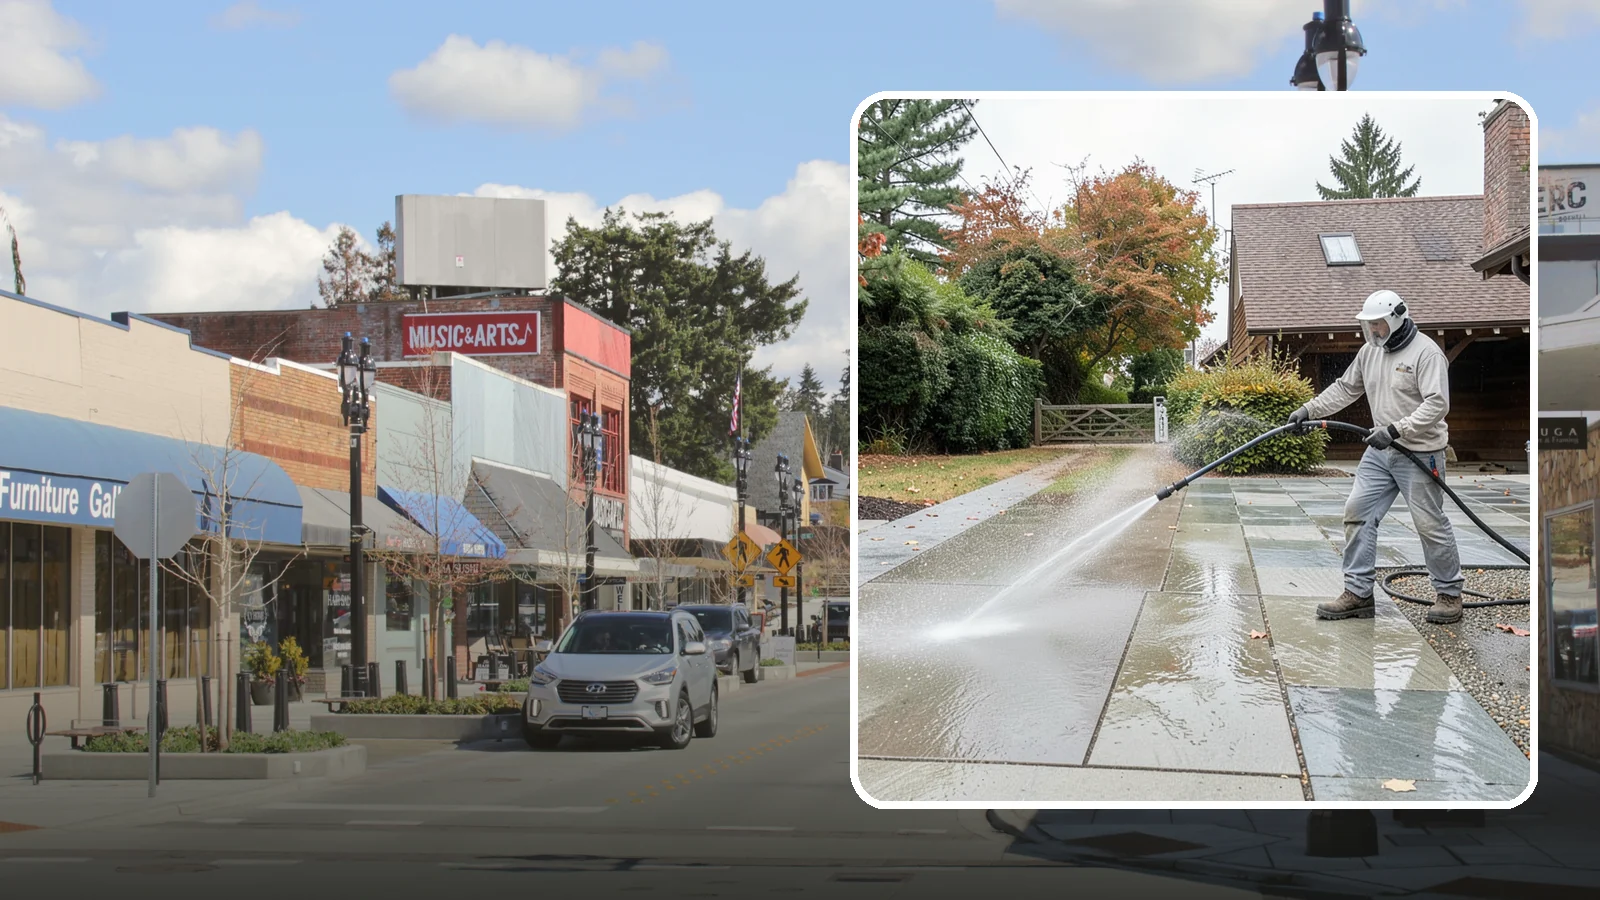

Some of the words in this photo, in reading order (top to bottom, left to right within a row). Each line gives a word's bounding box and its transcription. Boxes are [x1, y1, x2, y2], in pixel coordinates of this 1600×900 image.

[1540, 427, 1577, 437] UGA
[0, 471, 79, 515] Furniture
[90, 482, 122, 519] Gal
[453, 563, 479, 574] SUSHI
